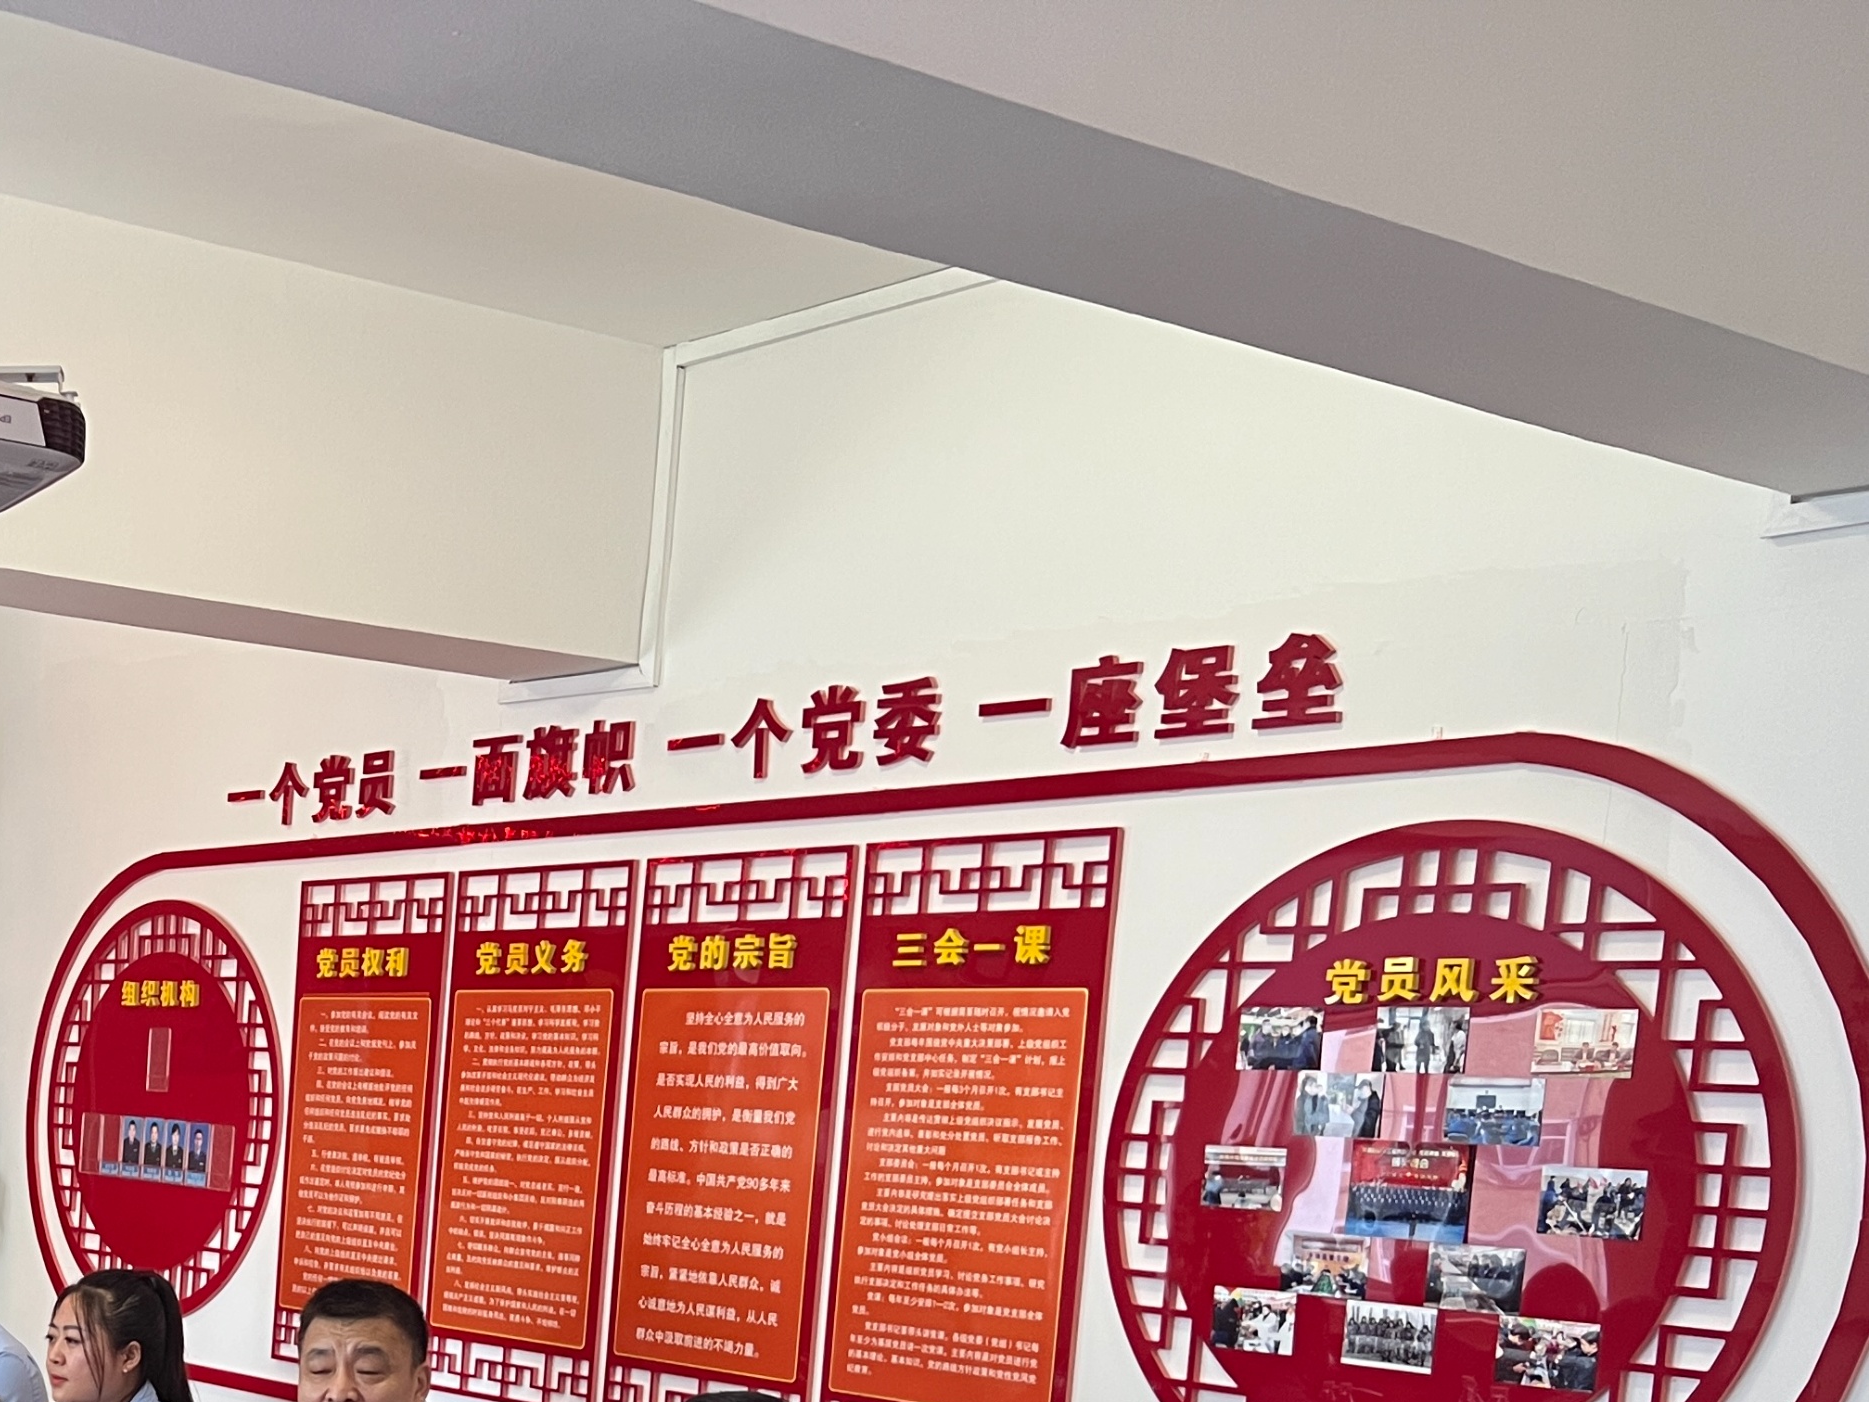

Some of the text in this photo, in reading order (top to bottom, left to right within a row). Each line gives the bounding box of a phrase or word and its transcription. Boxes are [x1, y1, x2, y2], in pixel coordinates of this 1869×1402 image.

[227, 631, 1344, 826] 一个党员 一面旗帜 一个党委 一座堡垒
[315, 946, 410, 978] 党员权利
[475, 938, 590, 976] 党员义务
[667, 933, 799, 972] 党的宗旨
[892, 924, 1053, 969] 三会一课
[121, 979, 200, 1008] 组织机构
[1324, 954, 1543, 1005] 党员风采
